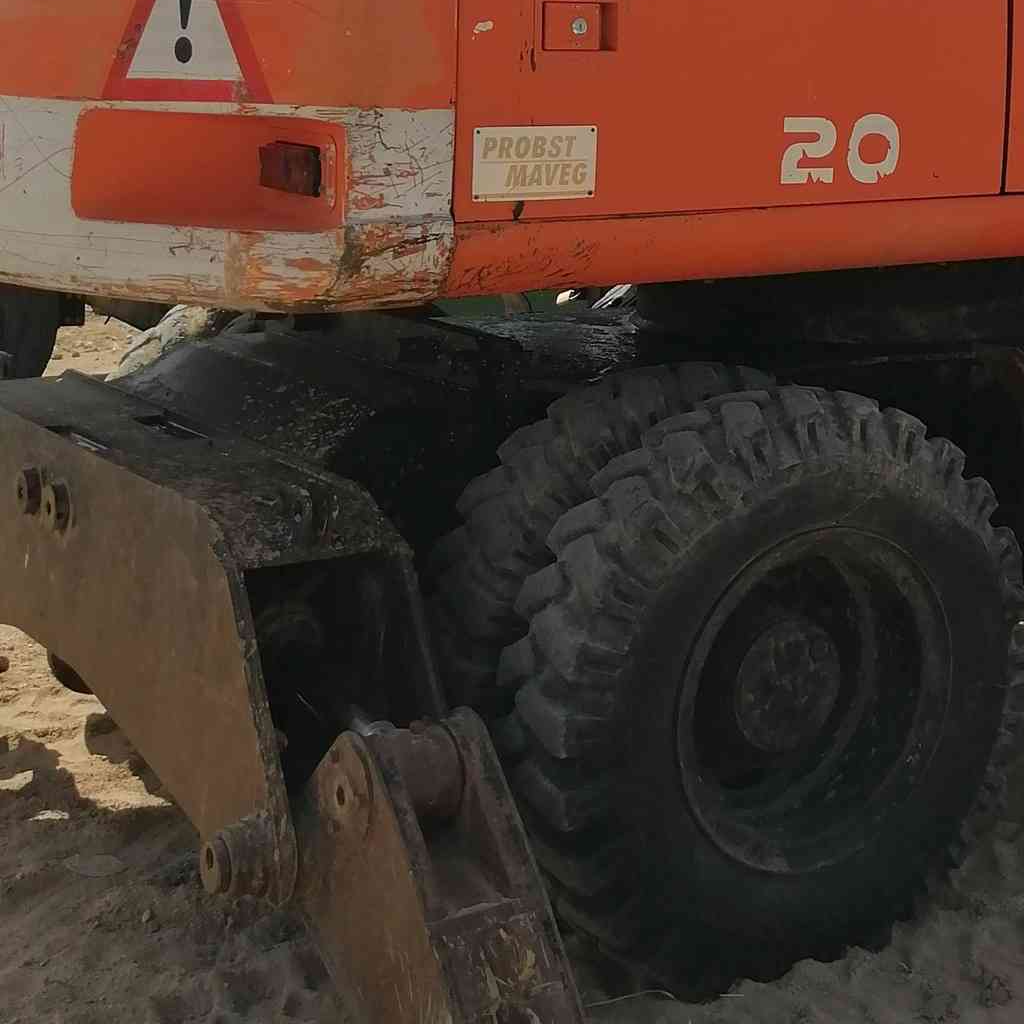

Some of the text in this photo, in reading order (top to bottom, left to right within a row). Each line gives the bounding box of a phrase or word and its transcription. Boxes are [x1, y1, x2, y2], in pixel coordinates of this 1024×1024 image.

[481, 135, 577, 159] PROBST
[780, 113, 900, 184] 20
[504, 162, 587, 188] MAVEG
